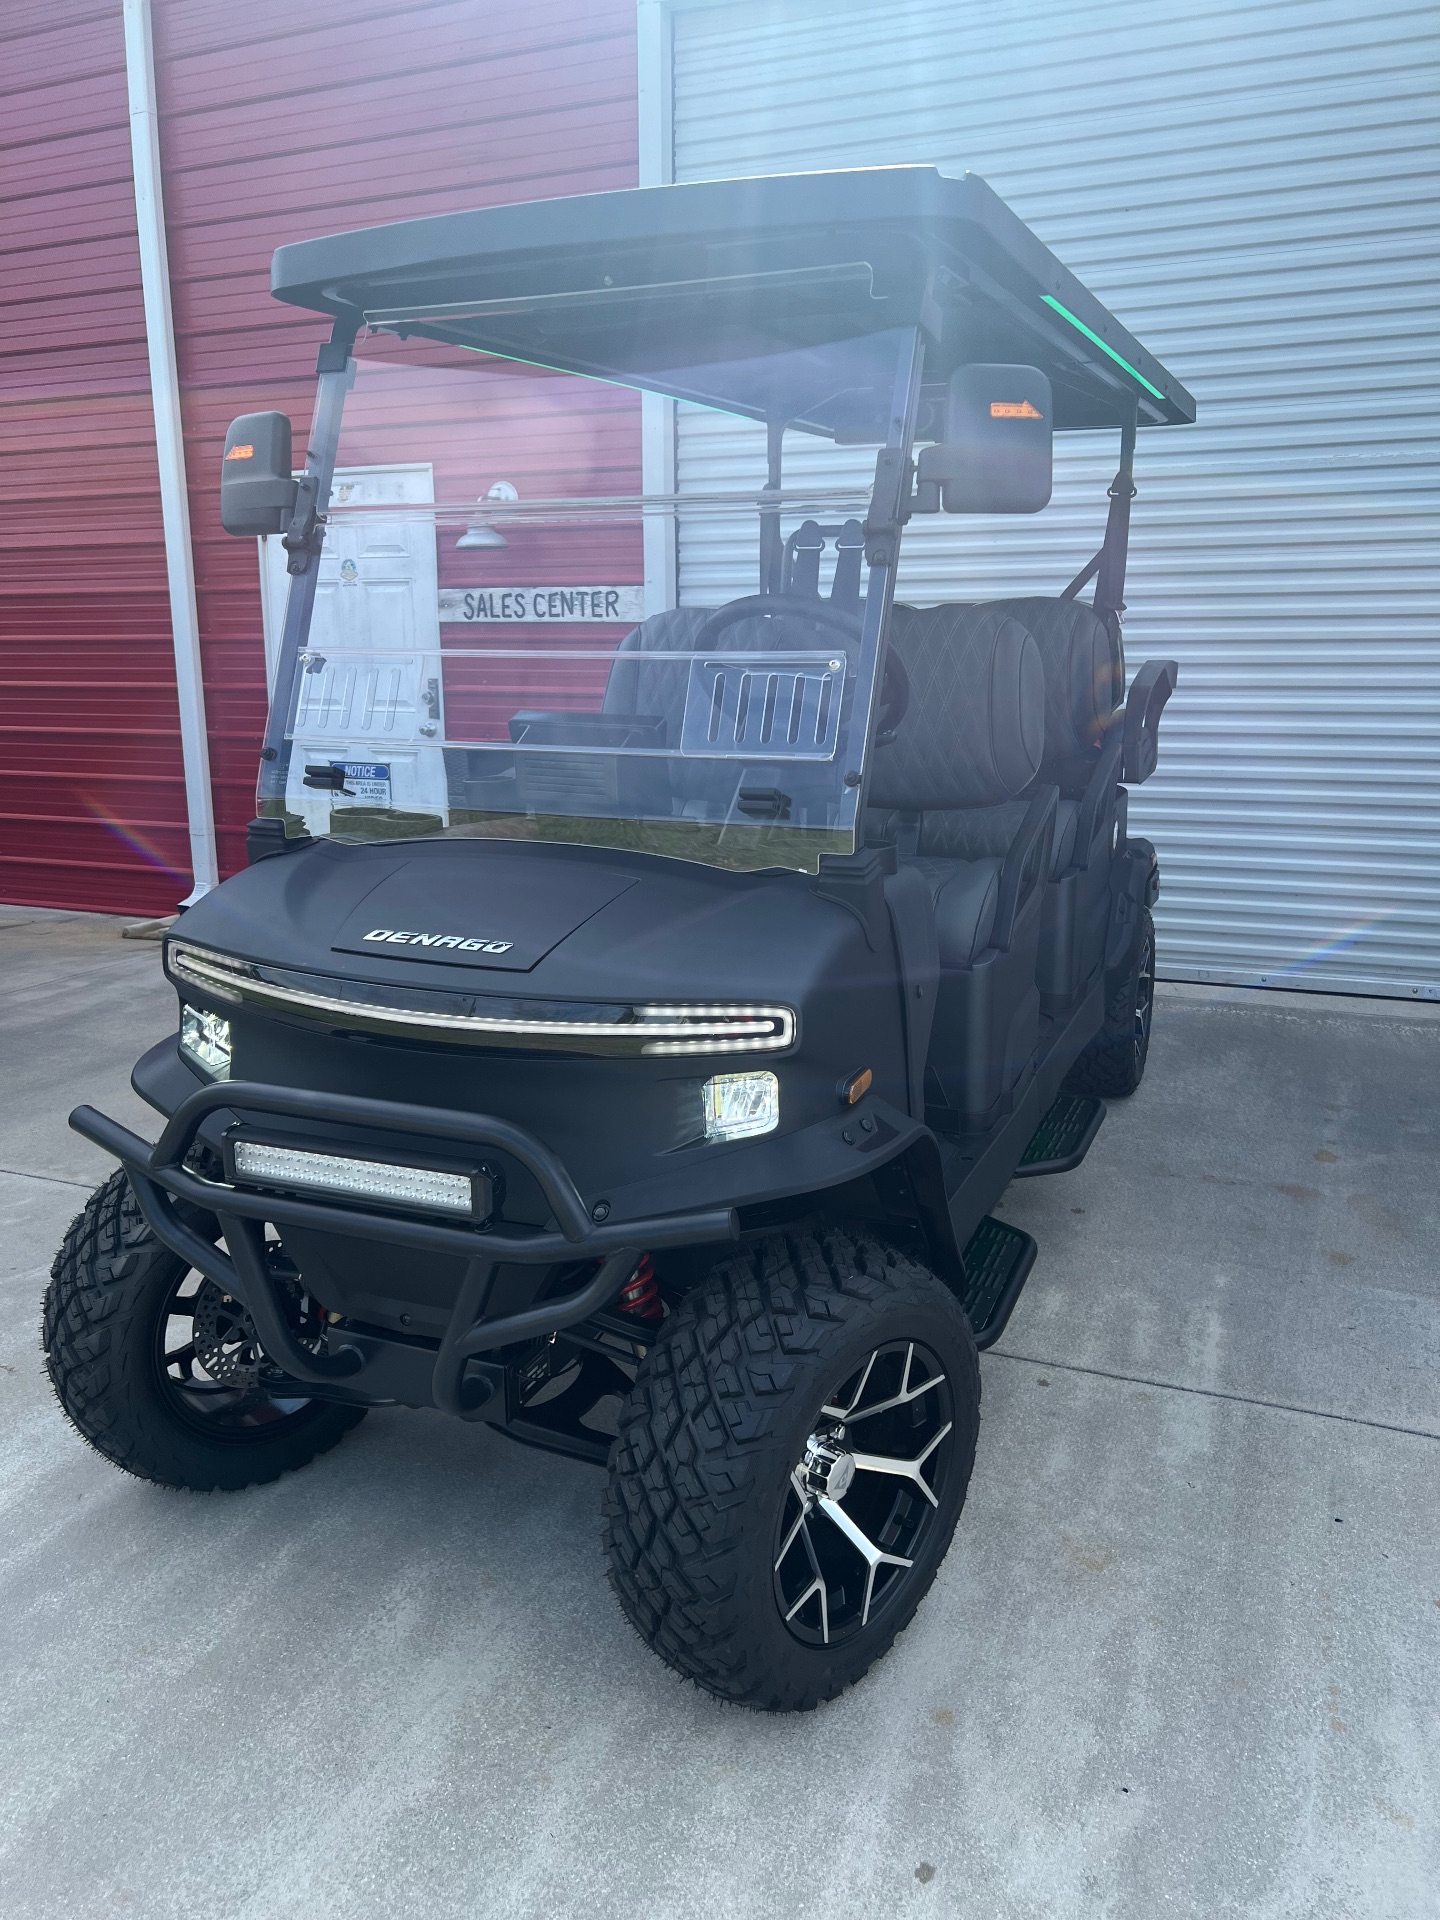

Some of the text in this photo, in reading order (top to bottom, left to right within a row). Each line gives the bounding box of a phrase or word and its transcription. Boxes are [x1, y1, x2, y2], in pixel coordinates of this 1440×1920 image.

[463, 590, 619, 620] SALES CENTER
[345, 765, 376, 777] NOTICE
[360, 787, 368, 795] 24
[363, 929, 514, 954] DENAGO
